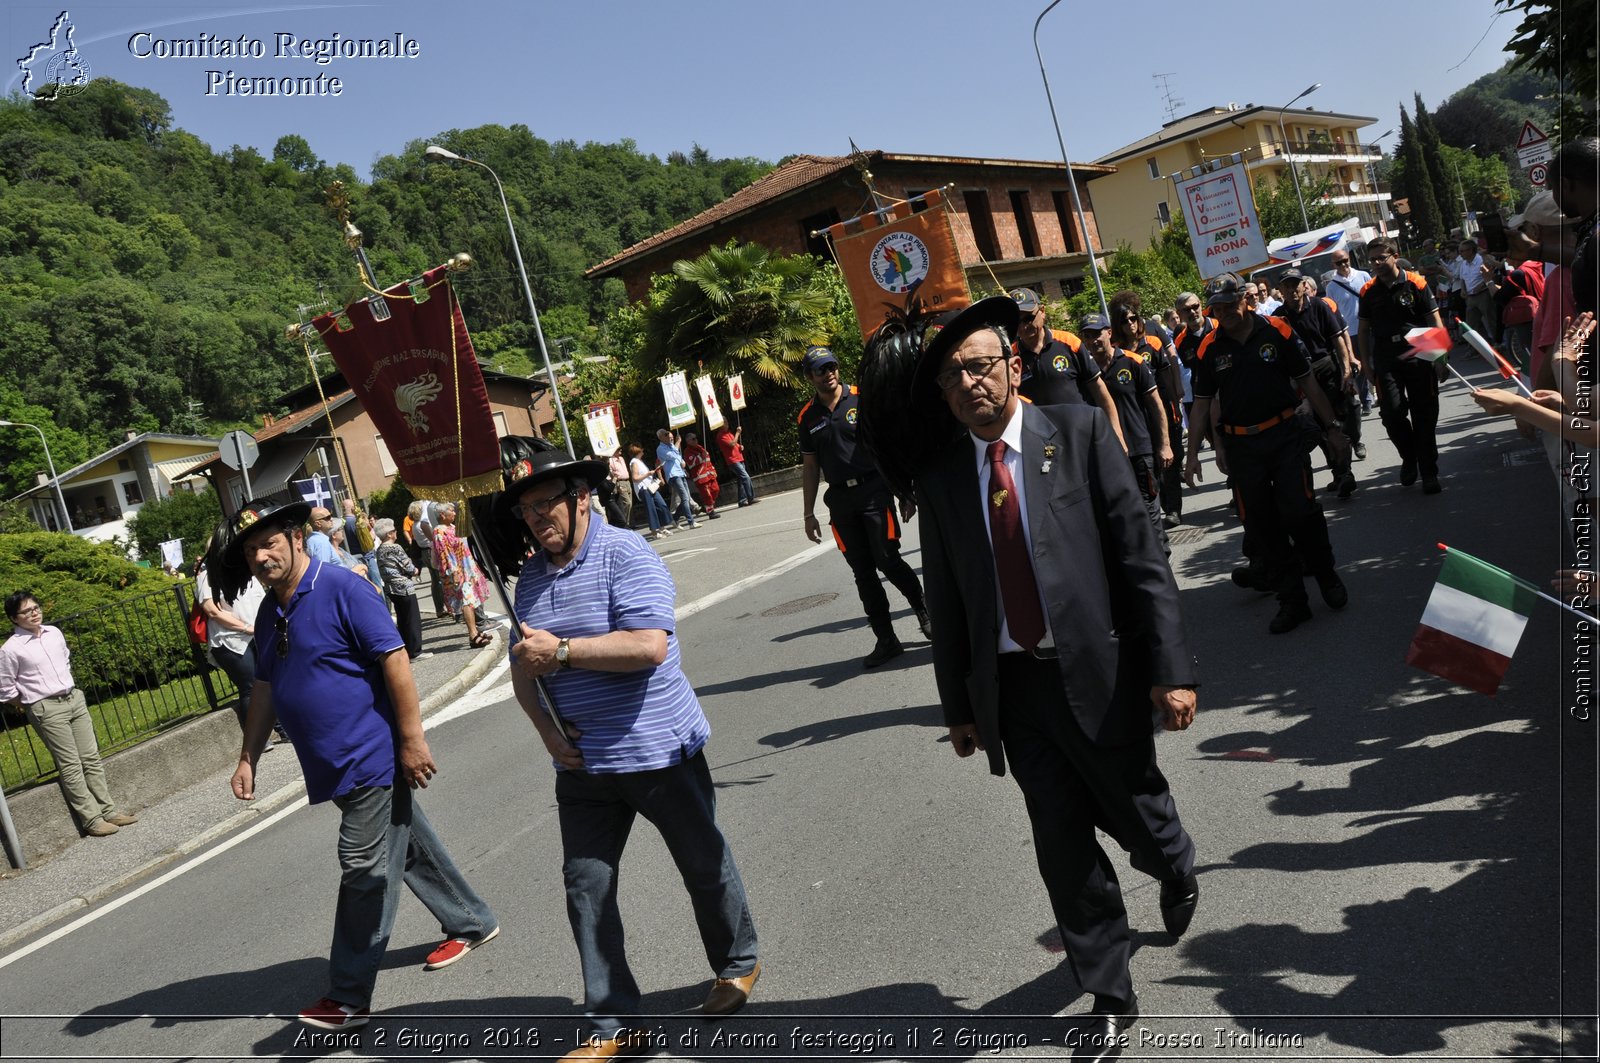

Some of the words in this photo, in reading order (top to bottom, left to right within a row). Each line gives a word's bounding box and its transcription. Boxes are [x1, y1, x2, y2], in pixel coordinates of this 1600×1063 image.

[1533, 169, 1545, 181] 30
[872, 234, 898, 260] VOLONTARI
[913, 239, 929, 270] PIEMONTE
[1206, 238, 1249, 257] ARONA
[1221, 256, 1240, 266] 1983
[872, 261, 884, 283] CORPO
